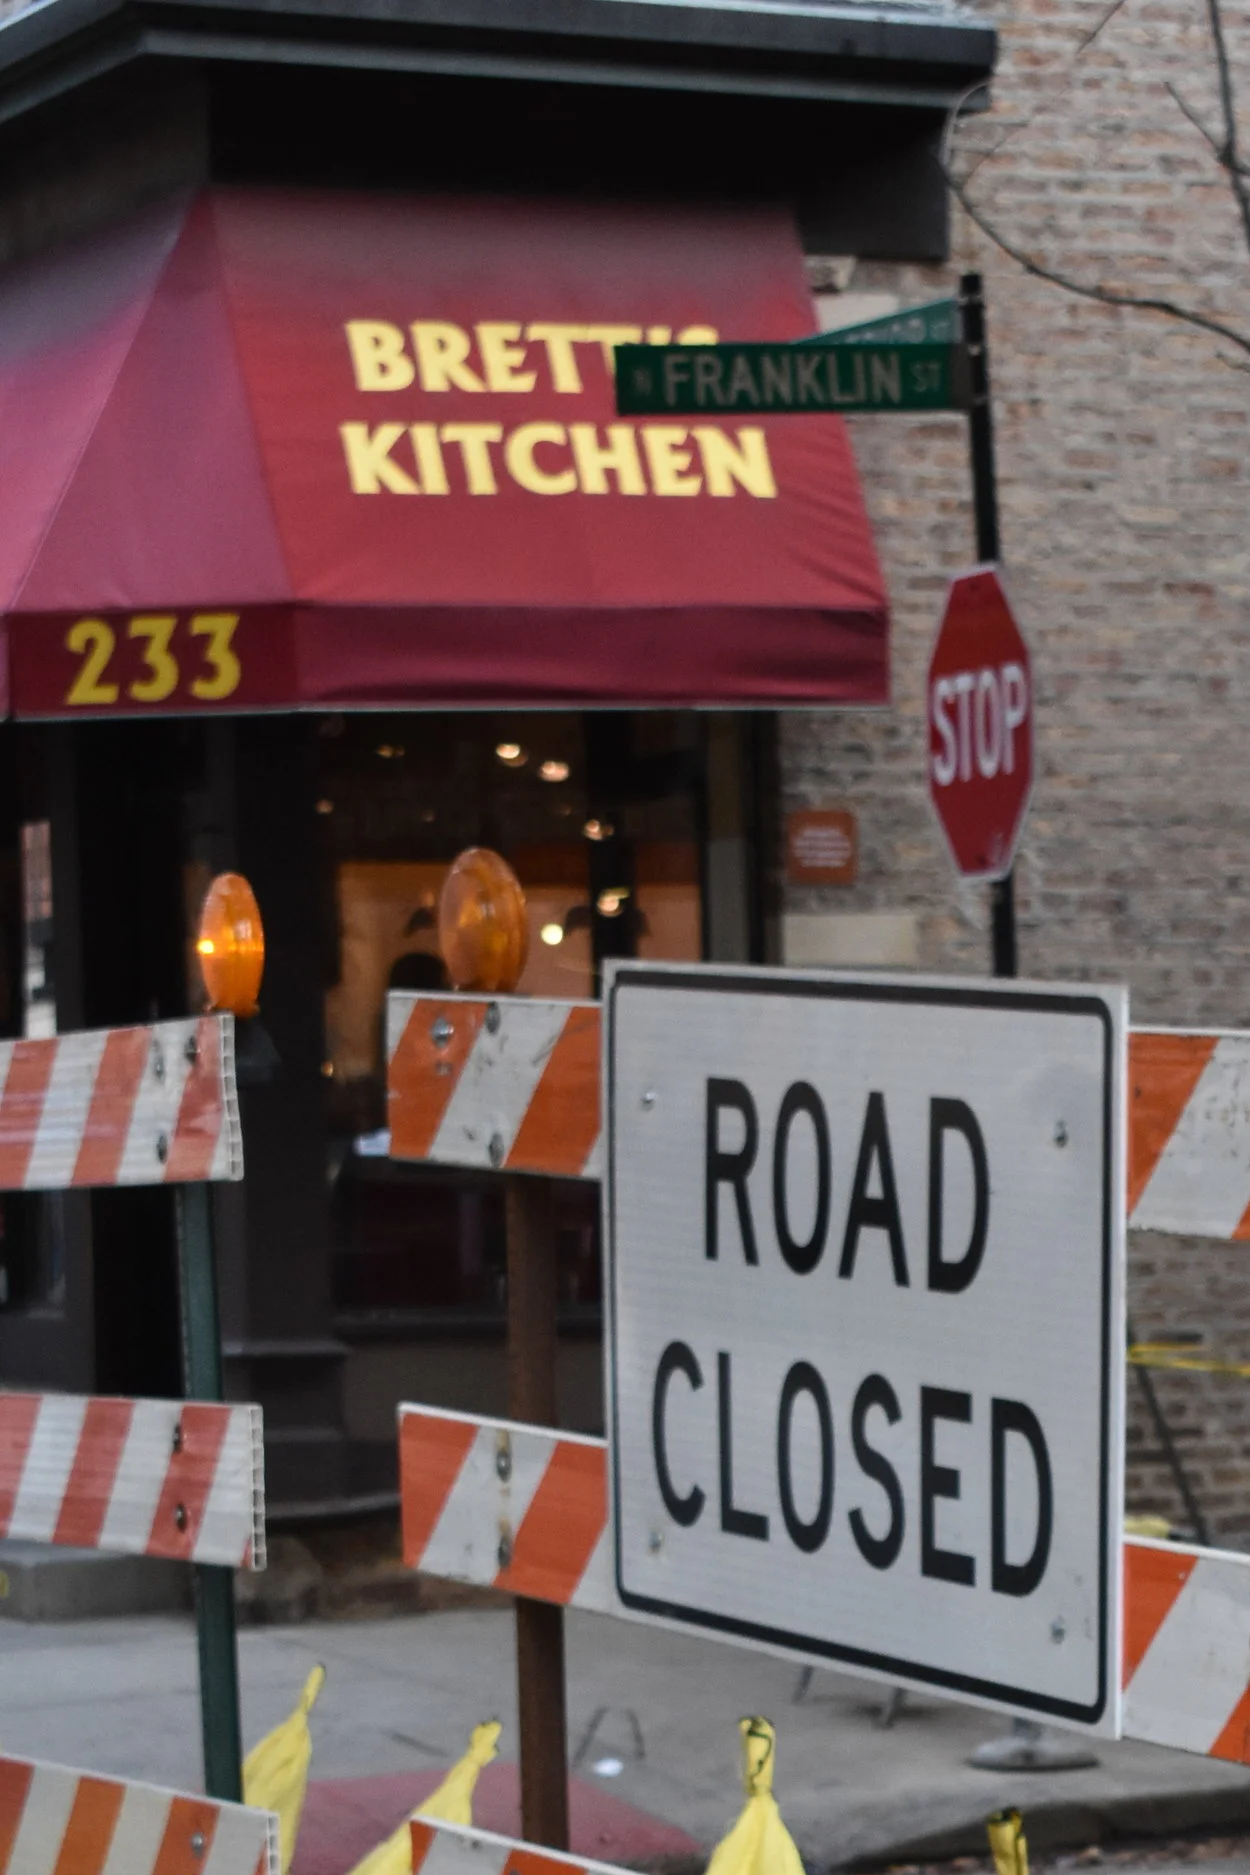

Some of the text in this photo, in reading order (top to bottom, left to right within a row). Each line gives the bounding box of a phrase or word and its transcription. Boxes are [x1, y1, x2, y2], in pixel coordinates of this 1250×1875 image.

[663, 352, 901, 406] FRANKLIN
[911, 361, 942, 393] ST
[339, 421, 778, 499] KITCHEN
[65, 613, 241, 705] 233
[933, 663, 1027, 786] STOP
[705, 1076, 990, 1294] ROAD
[652, 1340, 1054, 1598] CLOSED
